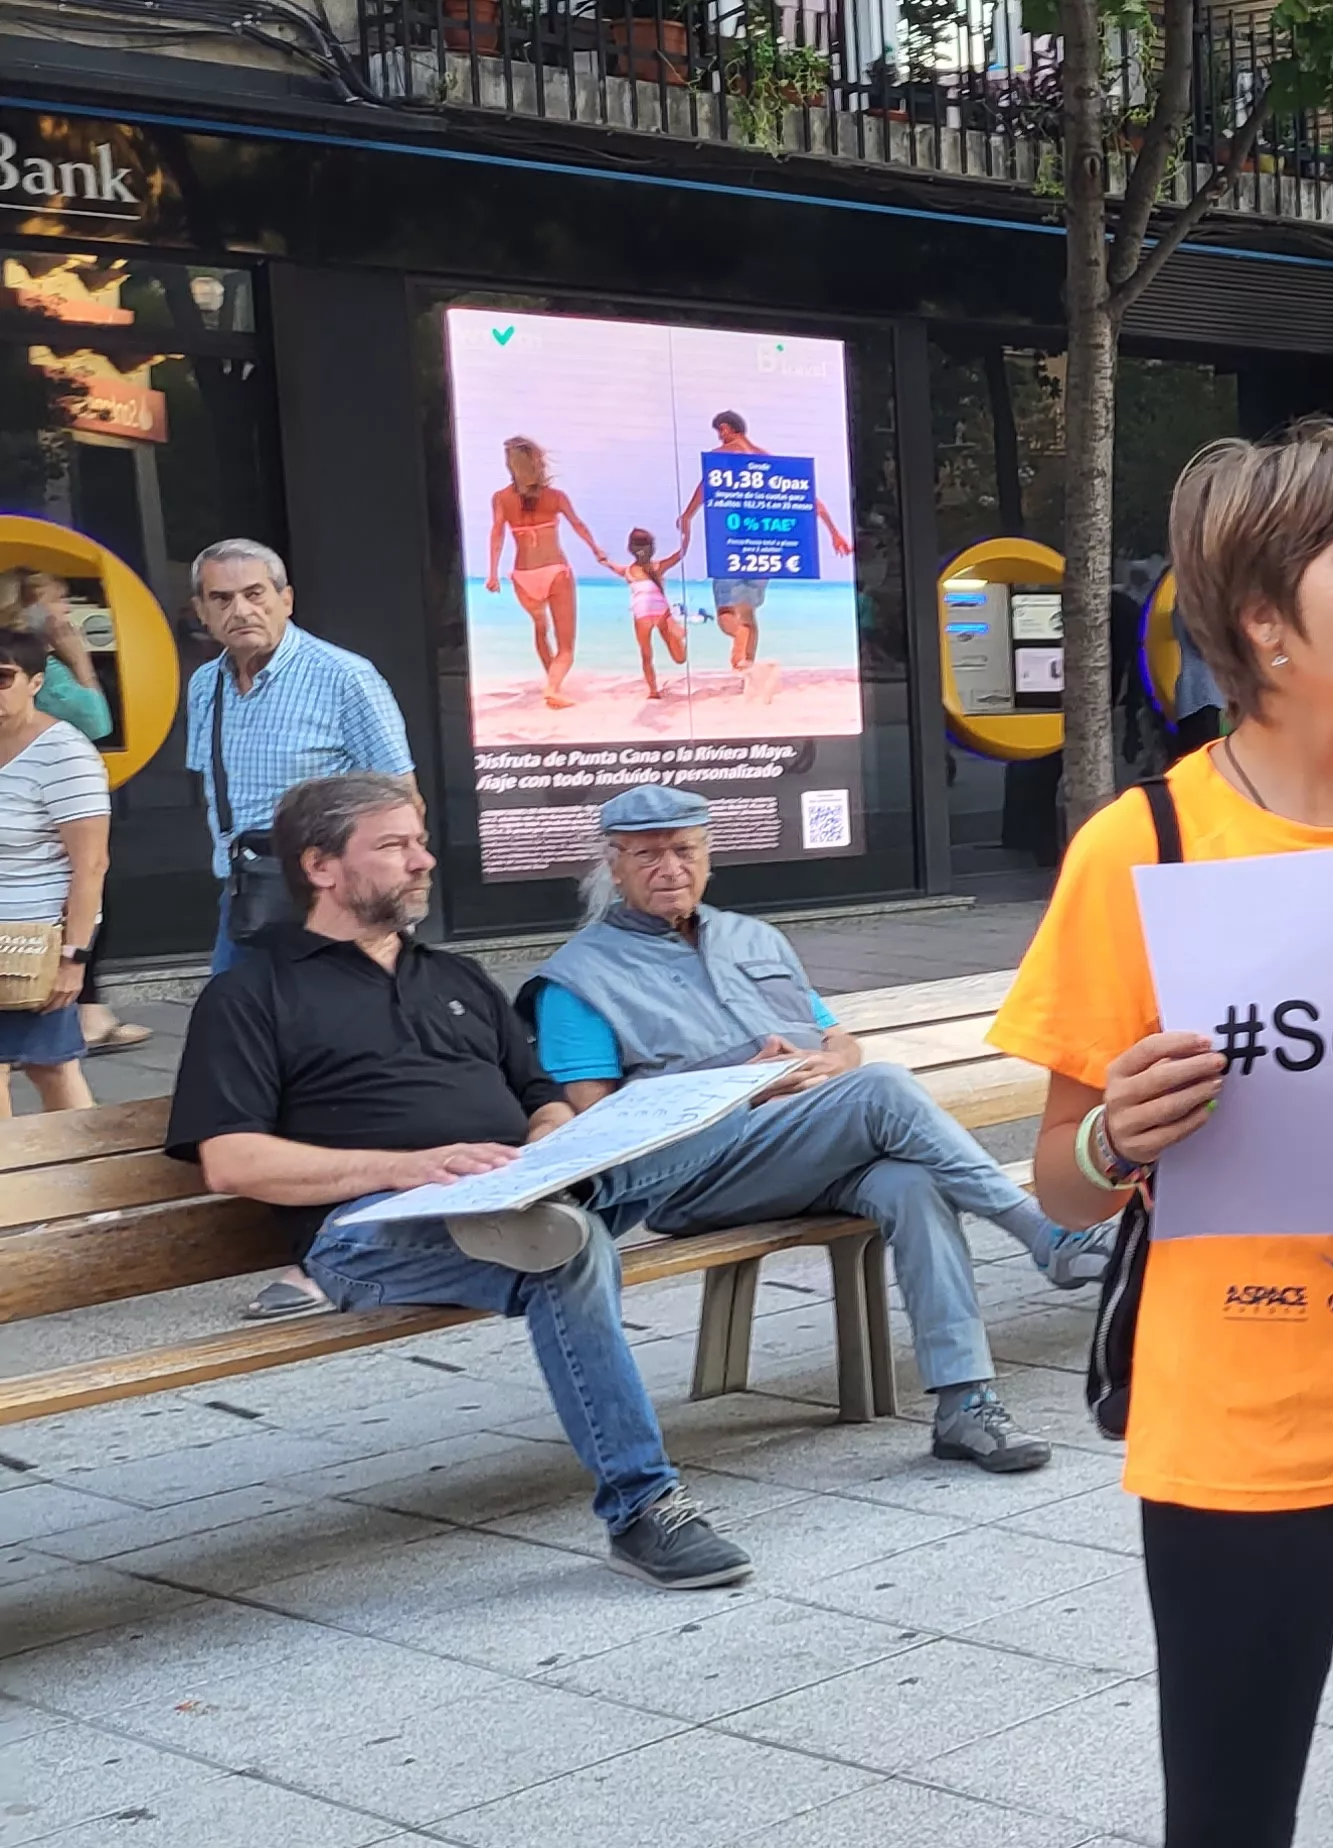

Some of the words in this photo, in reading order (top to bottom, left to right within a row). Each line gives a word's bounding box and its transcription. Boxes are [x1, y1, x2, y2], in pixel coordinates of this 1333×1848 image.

[708, 469, 764, 489] 81,38
[727, 513, 741, 531] 0
[744, 517, 759, 531] %
[727, 554, 782, 572] 3.255
[785, 555, 801, 573] €
[543, 750, 567, 767] de
[567, 750, 618, 767] Punta
[619, 748, 660, 765] Cana
[662, 750, 675, 763] o
[676, 746, 693, 763] la
[694, 745, 749, 762] Riviera
[750, 744, 797, 762] Maya.
[518, 774, 551, 789] con
[552, 769, 595, 787] todo
[661, 769, 676, 786] y
[674, 762, 785, 786] personalizado
